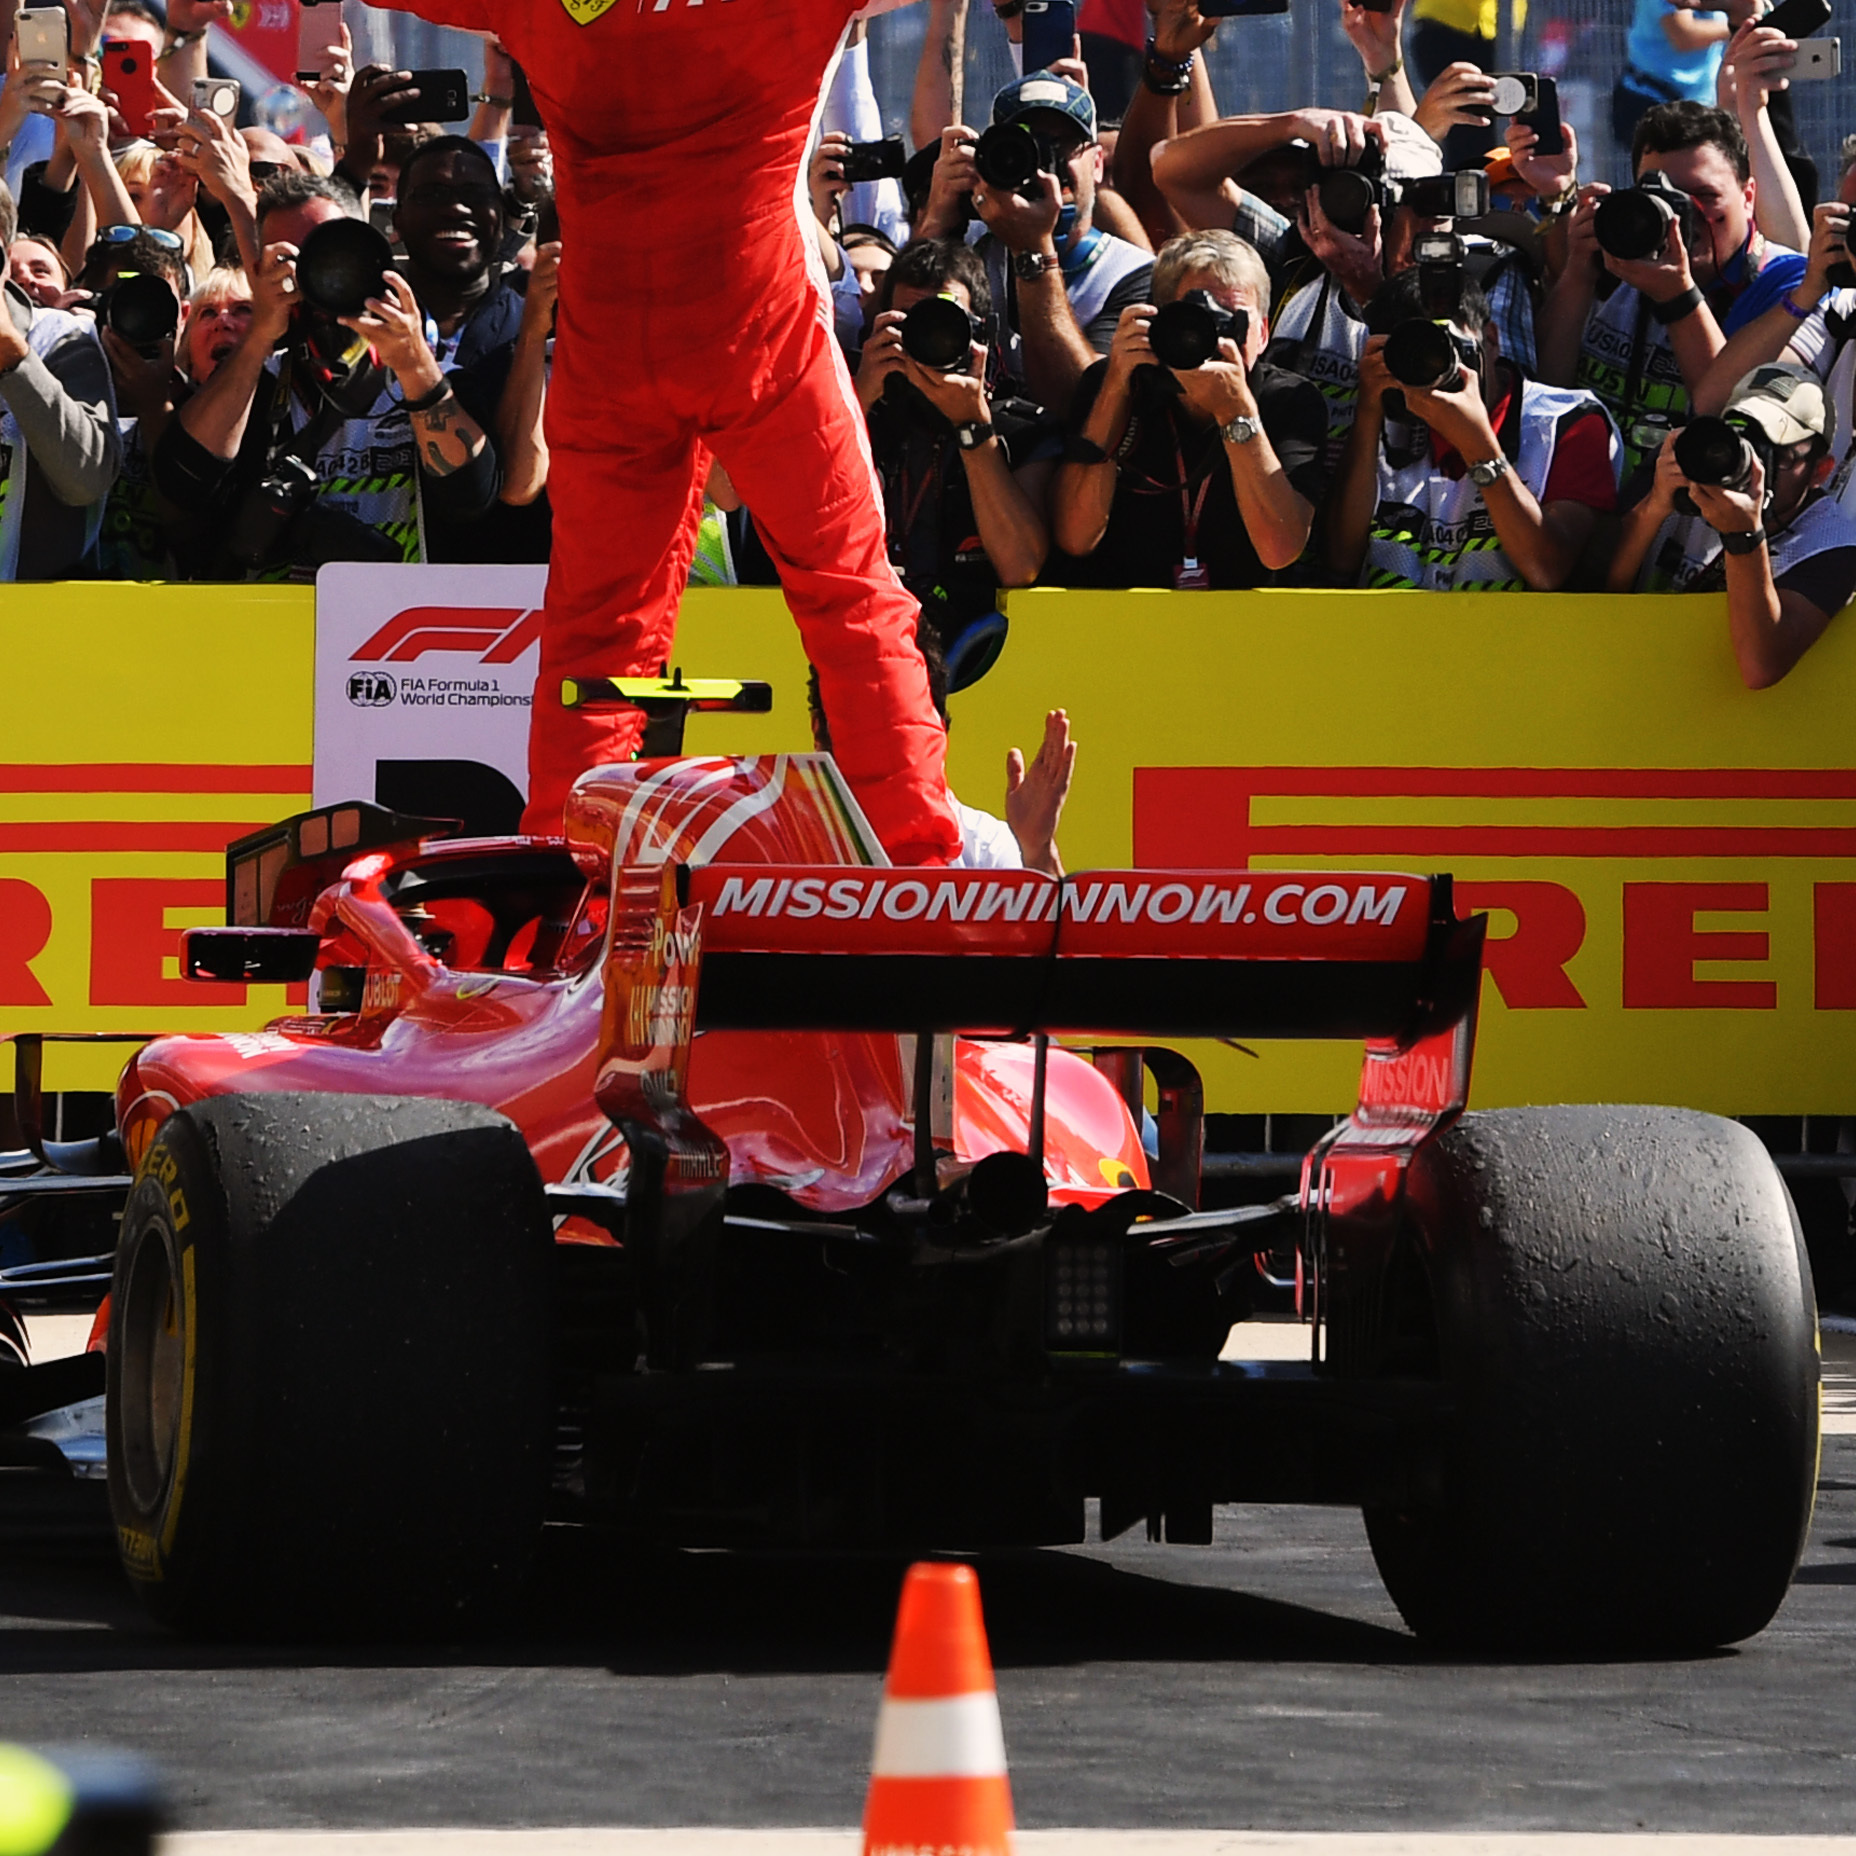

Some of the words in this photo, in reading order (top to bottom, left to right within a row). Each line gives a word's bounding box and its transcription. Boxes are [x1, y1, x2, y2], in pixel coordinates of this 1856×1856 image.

[400, 678, 426, 692] FIA
[428, 678, 488, 692] Formula
[489, 678, 500, 692] 1
[400, 693, 444, 706] World
[711, 876, 1407, 927] MISSIONWINNOW.COM
[1363, 1054, 1449, 1105] MISSION
